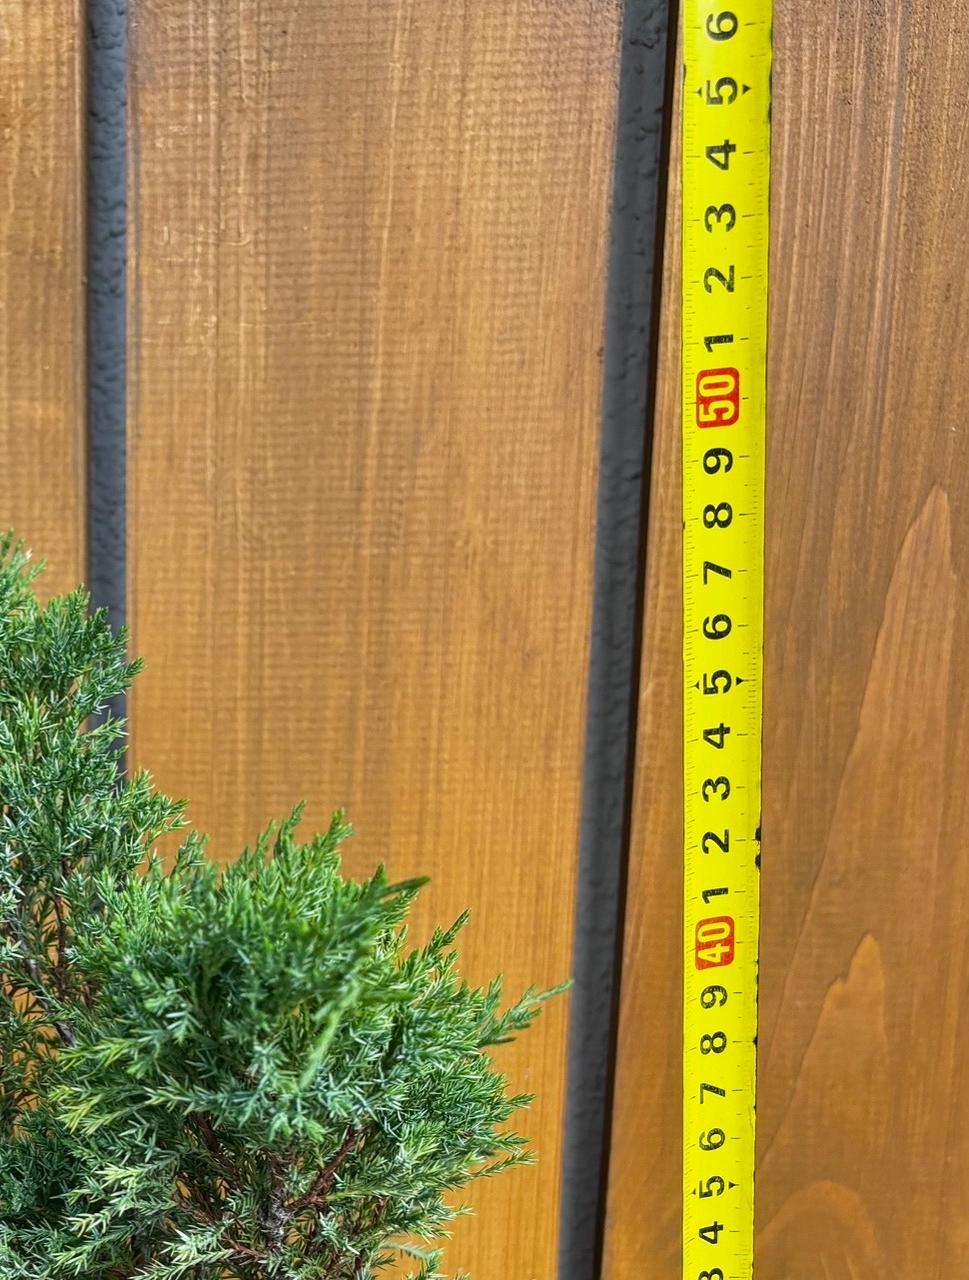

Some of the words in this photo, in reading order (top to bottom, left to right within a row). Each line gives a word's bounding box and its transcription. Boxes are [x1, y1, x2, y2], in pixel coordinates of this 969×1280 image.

[707, 12, 738, 41] 6
[706, 77, 737, 105] 5
[705, 140, 736, 170] 4
[705, 204, 736, 232] 3
[704, 265, 735, 293] 2
[704, 334, 734, 353] 1
[698, 369, 736, 425] 50
[703, 448, 733, 474] 9
[703, 502, 733, 528] 8
[703, 561, 732, 585] 7
[703, 614, 732, 640] 6
[703, 670, 731, 695] 5
[703, 723, 731, 749] 4
[702, 777, 730, 802] 3
[702, 830, 729, 854] 2
[702, 887, 729, 905] 1
[697, 919, 732, 967] 40
[701, 985, 727, 1009] 9
[700, 1031, 727, 1054] 8
[700, 1083, 725, 1104] 7
[699, 1128, 725, 1151] 6
[699, 1176, 725, 1199] 5
[699, 1221, 724, 1244] 4
